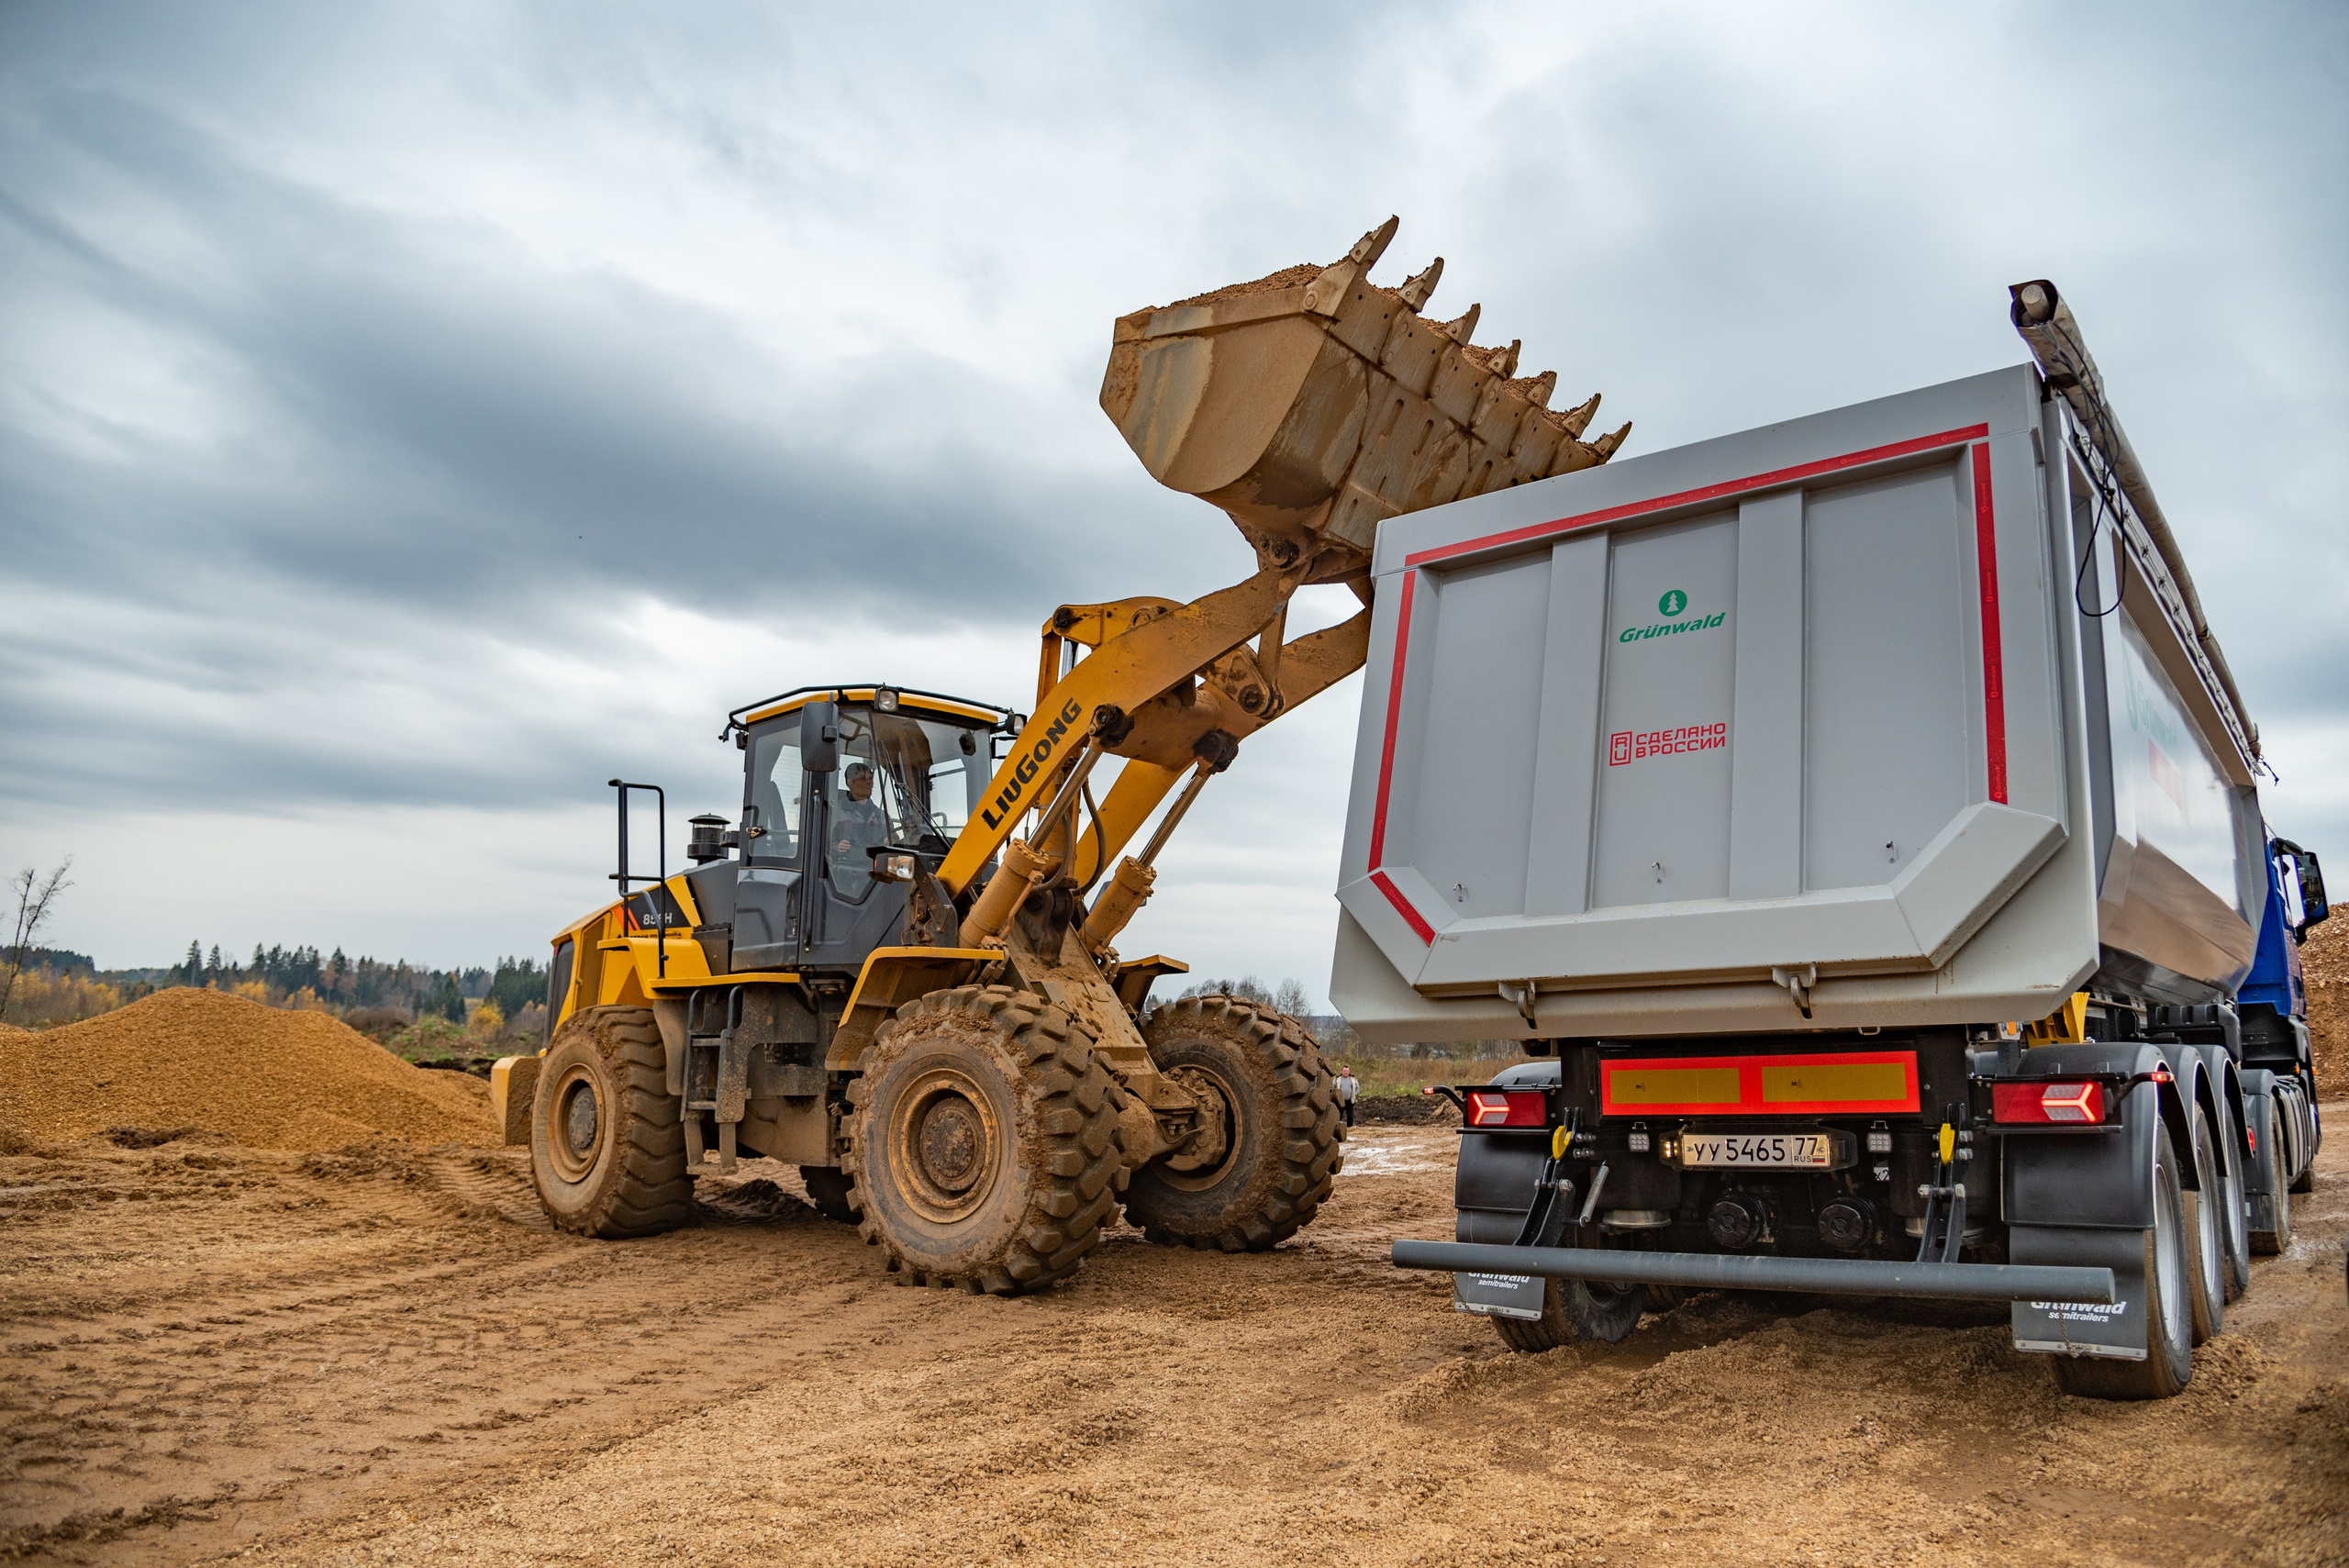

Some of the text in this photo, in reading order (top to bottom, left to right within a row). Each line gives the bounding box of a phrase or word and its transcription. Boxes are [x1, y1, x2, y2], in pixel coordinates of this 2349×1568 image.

[1620, 612, 1726, 642] Grünwald
[1636, 722, 1726, 745] СДЕЛАНО
[1650, 736, 1726, 756] РОССИИ
[981, 696, 1083, 831] LIUGONG
[1725, 1139, 1786, 1162] 5465
[1795, 1137, 1819, 1156] 77
[1477, 1279, 1520, 1290] semitrailers
[2048, 1311, 2110, 1323] semitrailers
